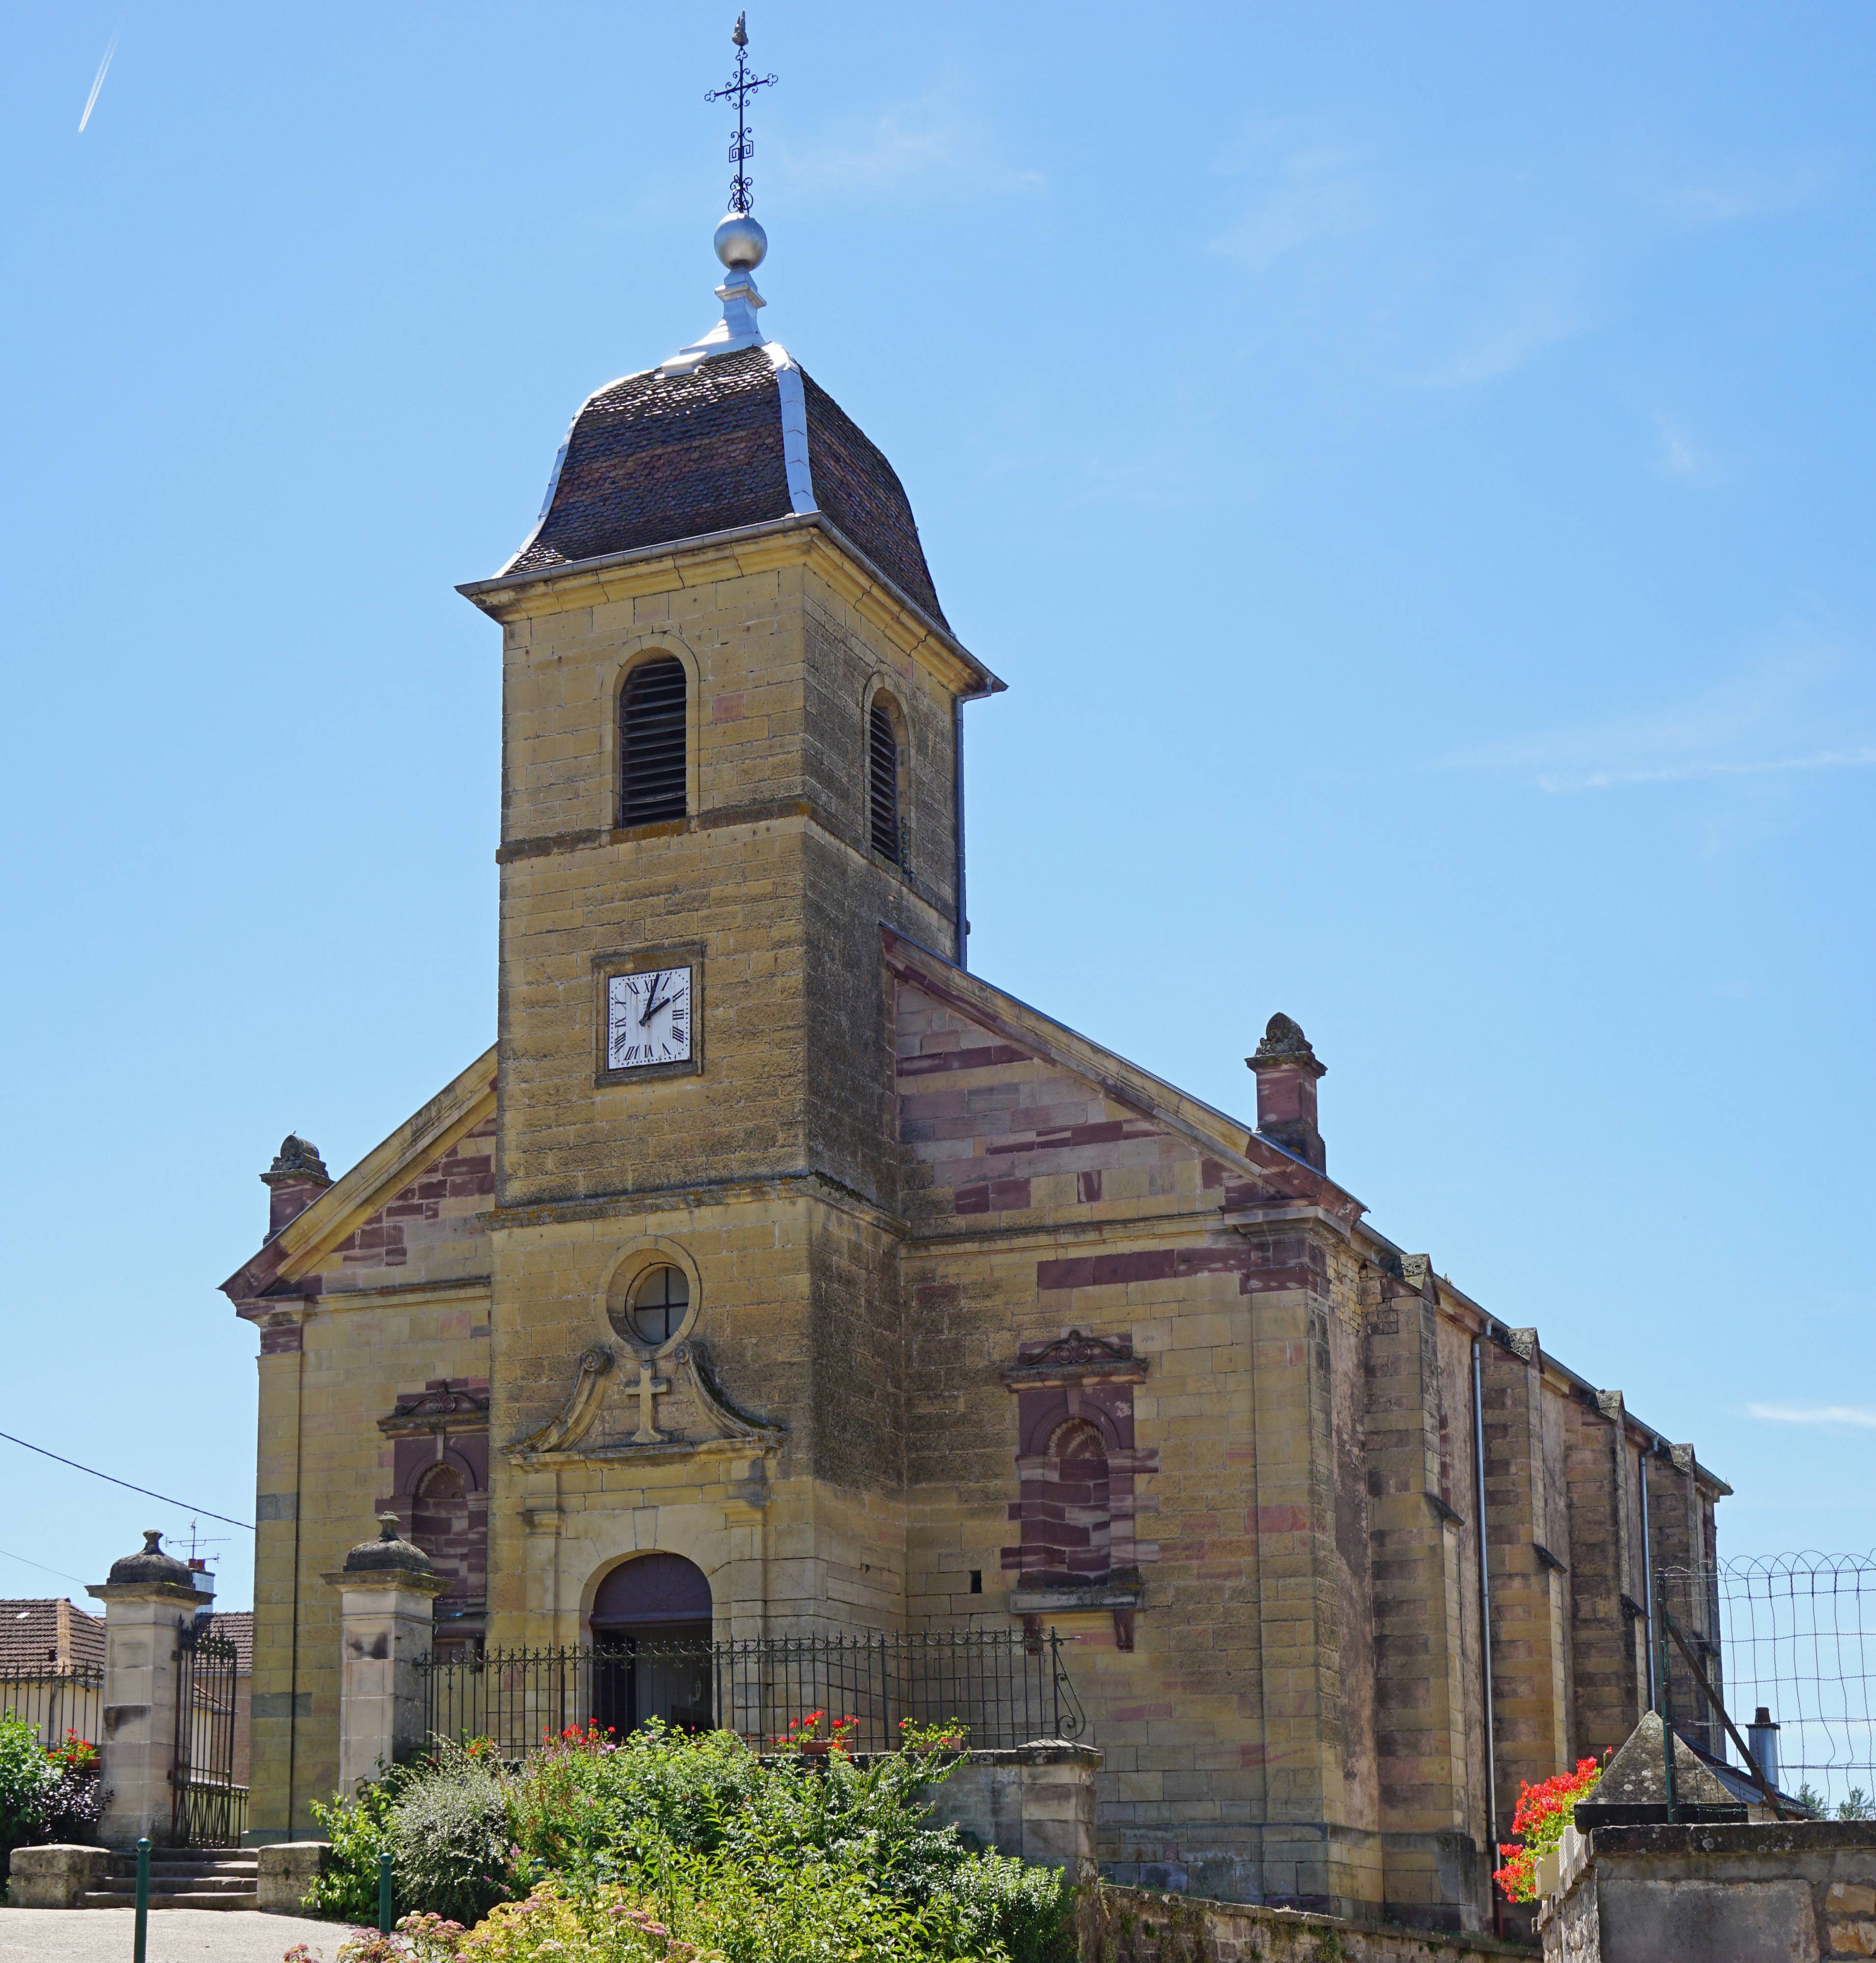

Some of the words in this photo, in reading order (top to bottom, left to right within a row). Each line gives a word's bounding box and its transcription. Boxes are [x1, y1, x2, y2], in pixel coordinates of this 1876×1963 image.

[625, 982, 640, 994] XI
[660, 977, 670, 991] I
[615, 994, 626, 1010] X
[672, 987, 684, 1004] II
[672, 1008, 684, 1021] III
[615, 1016, 626, 1028] IX
[672, 1025, 684, 1044] IIII
[615, 1031, 626, 1055] VIII
[662, 1042, 671, 1055] V
[623, 1045, 639, 1061] VII
[644, 1044, 654, 1058] VI
